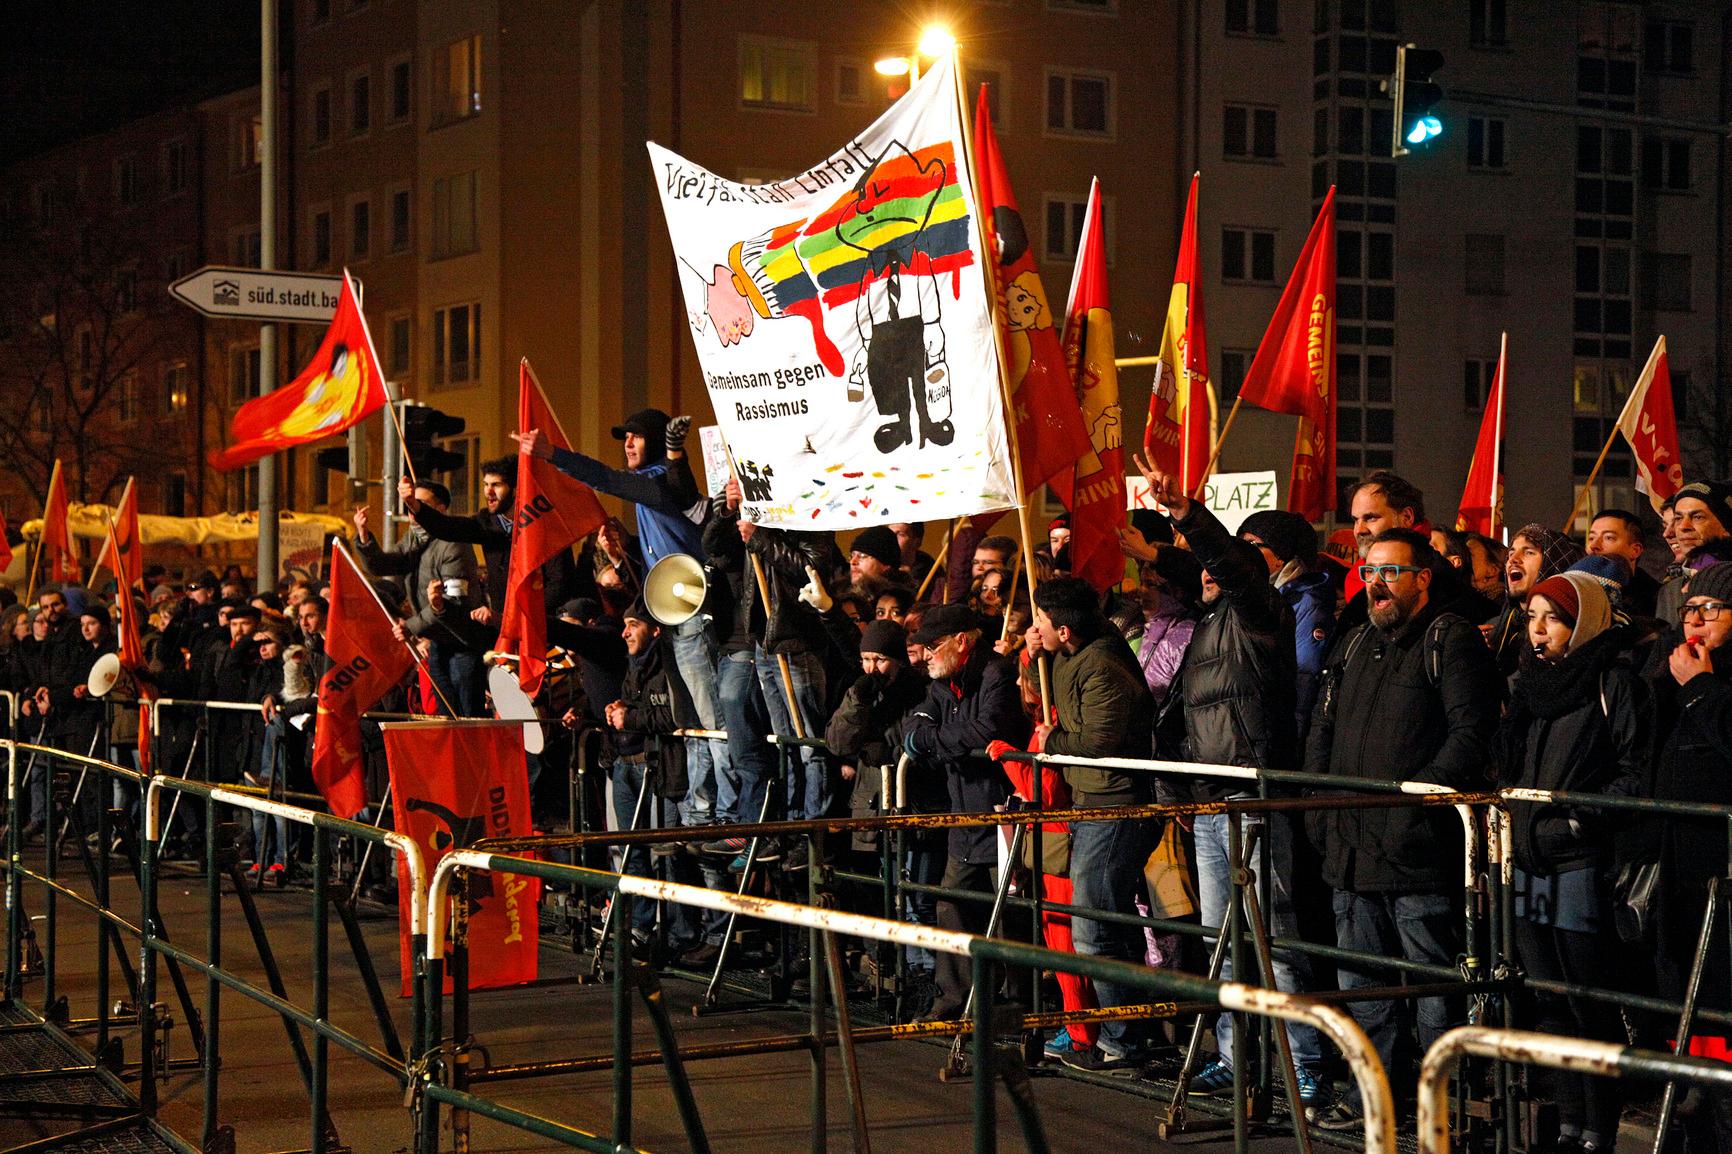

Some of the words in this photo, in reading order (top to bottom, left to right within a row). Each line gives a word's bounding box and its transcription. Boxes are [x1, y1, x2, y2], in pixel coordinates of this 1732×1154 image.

[248, 286, 338, 308] süd.stadt.ba
[707, 371, 772, 390] Gemeinsam
[774, 362, 826, 389] gegen
[735, 398, 809, 421] Rassismus
[1204, 480, 1274, 511] PLATZ
